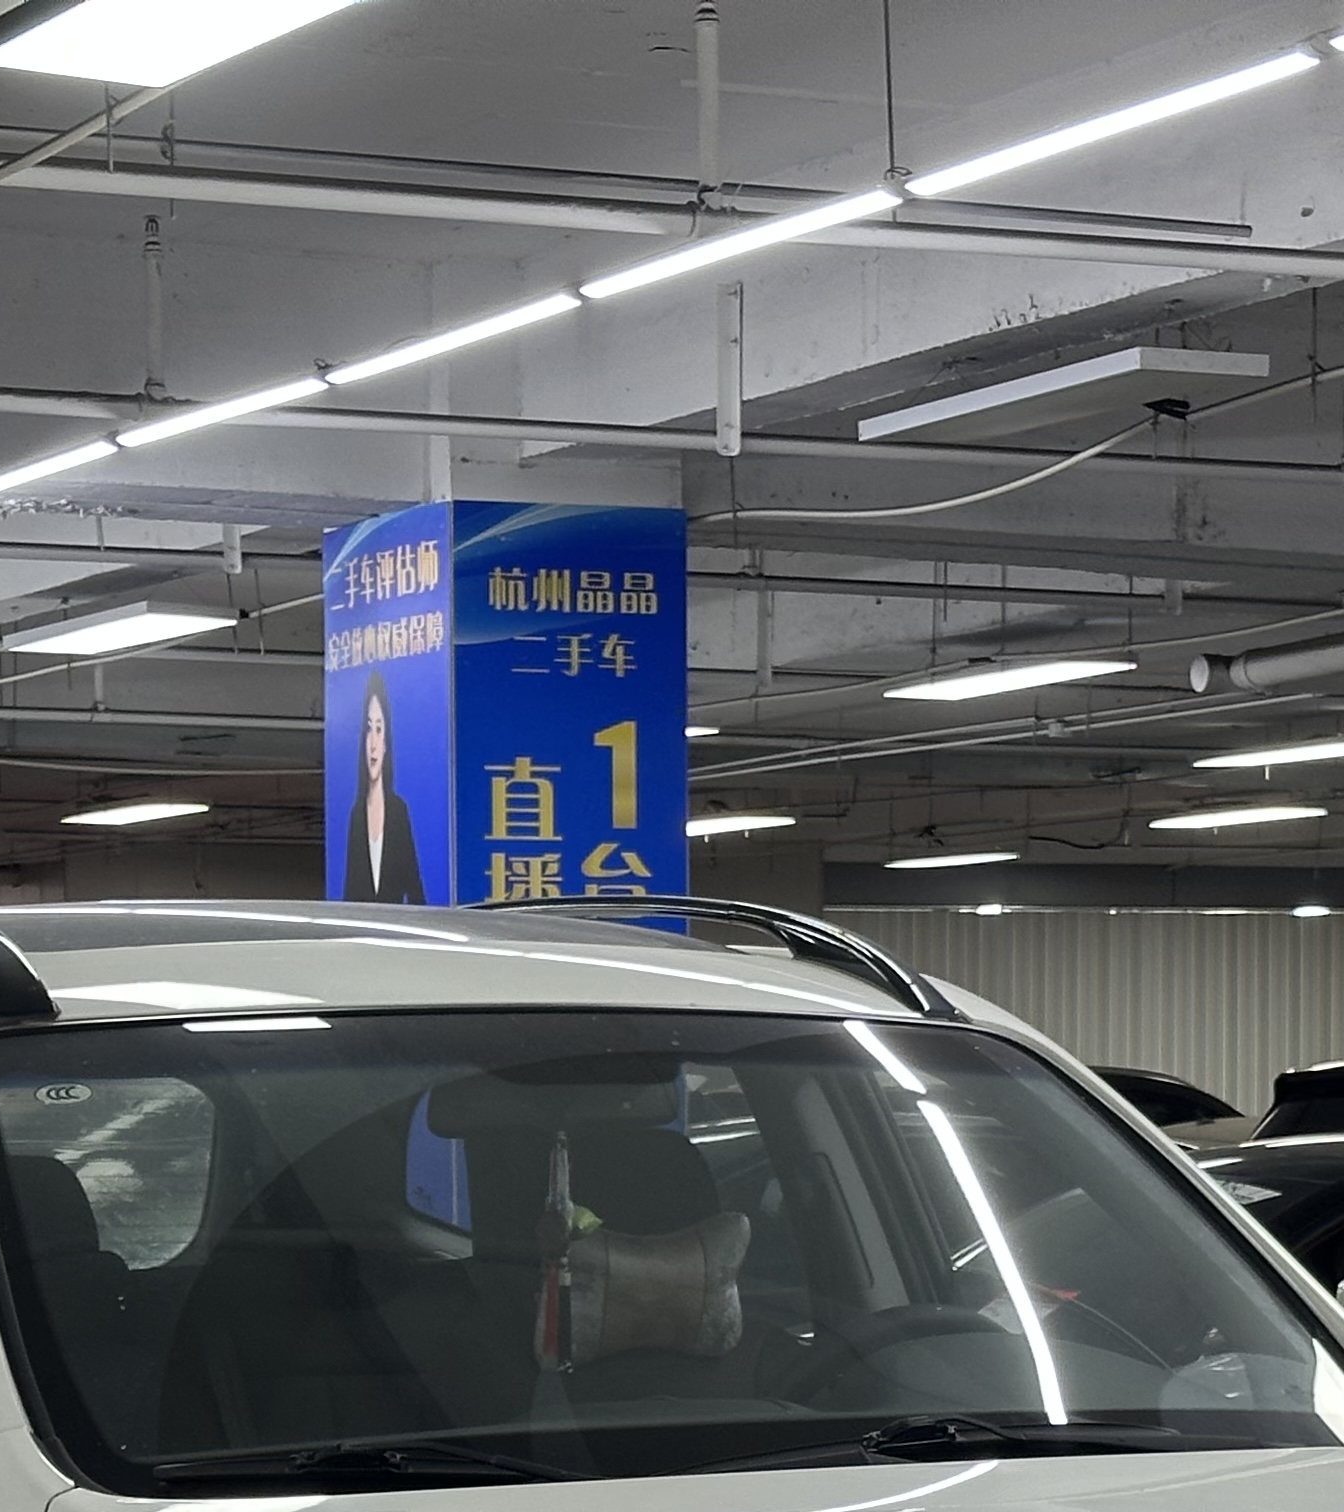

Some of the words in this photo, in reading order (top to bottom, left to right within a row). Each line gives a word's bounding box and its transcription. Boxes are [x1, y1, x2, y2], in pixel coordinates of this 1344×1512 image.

[330, 539, 439, 610] 二手车评估师
[487, 566, 658, 615] 杭州晶晶
[511, 633, 638, 678] 二手车
